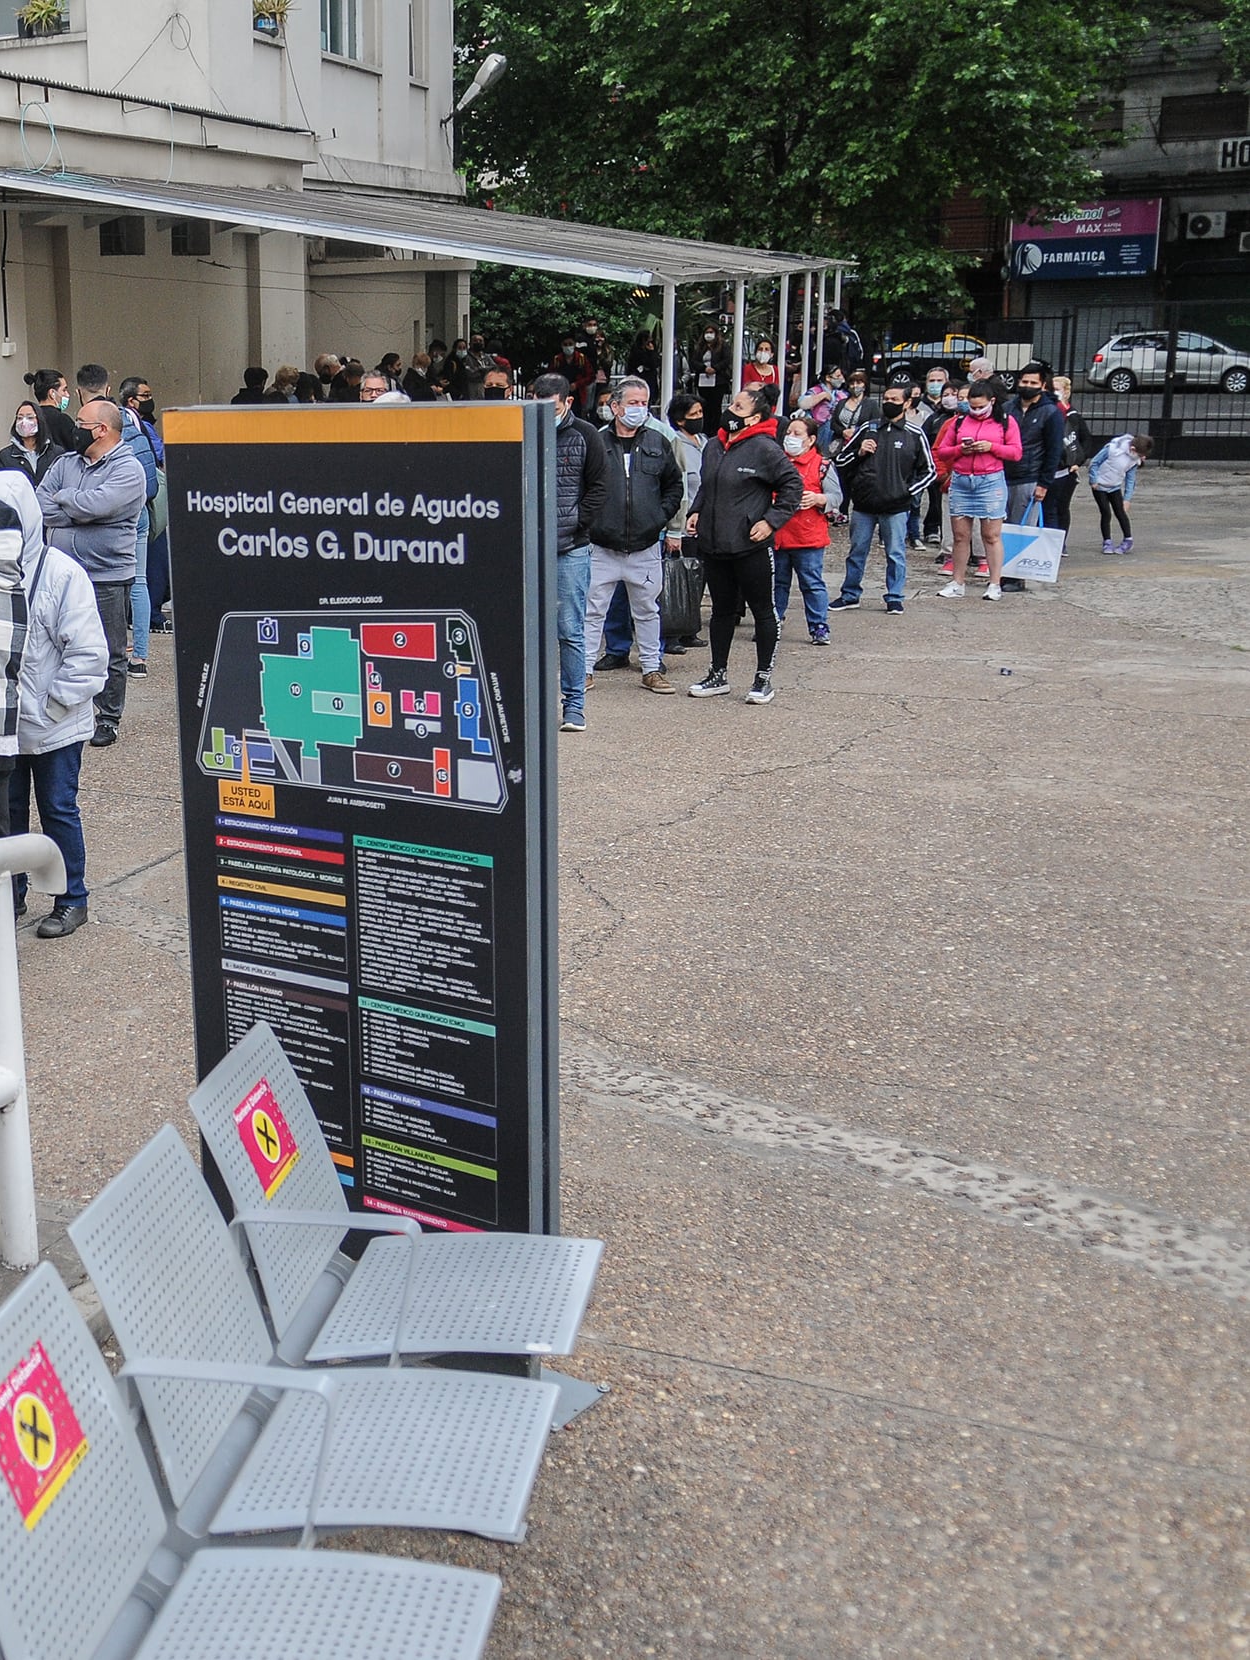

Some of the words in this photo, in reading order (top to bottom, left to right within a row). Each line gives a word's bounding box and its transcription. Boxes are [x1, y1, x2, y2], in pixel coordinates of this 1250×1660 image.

[1075, 223, 1102, 234] MAX
[1043, 250, 1106, 263] FARMATICA
[187, 491, 273, 518] Hospital
[279, 491, 368, 515] General
[375, 492, 404, 517] de
[410, 493, 500, 524] Agudos
[217, 527, 309, 558] Carlos
[316, 530, 345, 560] G.
[353, 531, 465, 565] Durand
[1017, 558, 1052, 568] ARGUS
[362, 595, 383, 604] LOBOS
[265, 626, 270, 636] 1
[455, 631, 463, 641] 3
[396, 635, 404, 645] 2
[301, 641, 309, 651] 9
[446, 665, 454, 675] 4
[370, 674, 380, 683] 14
[291, 686, 301, 694] 10
[490, 671, 502, 702] ARTURO
[334, 700, 342, 708] 11
[376, 703, 383, 713] 8
[416, 702, 424, 711] 14
[464, 705, 472, 715] 5
[418, 726, 425, 735] 6
[232, 746, 240, 754] 12
[216, 754, 224, 764] 13
[390, 765, 398, 775] 7
[438, 771, 447, 780] 15
[231, 786, 261, 797] USTED
[223, 797, 244, 807] ESTÁ
[248, 799, 271, 811] AQUÍ
[228, 859, 254, 869] PABELLÓN
[230, 900, 255, 910] PABELLÓN
[373, 1089, 401, 1101] PABELLÓN
[375, 1140, 402, 1153] PABELLÓN
